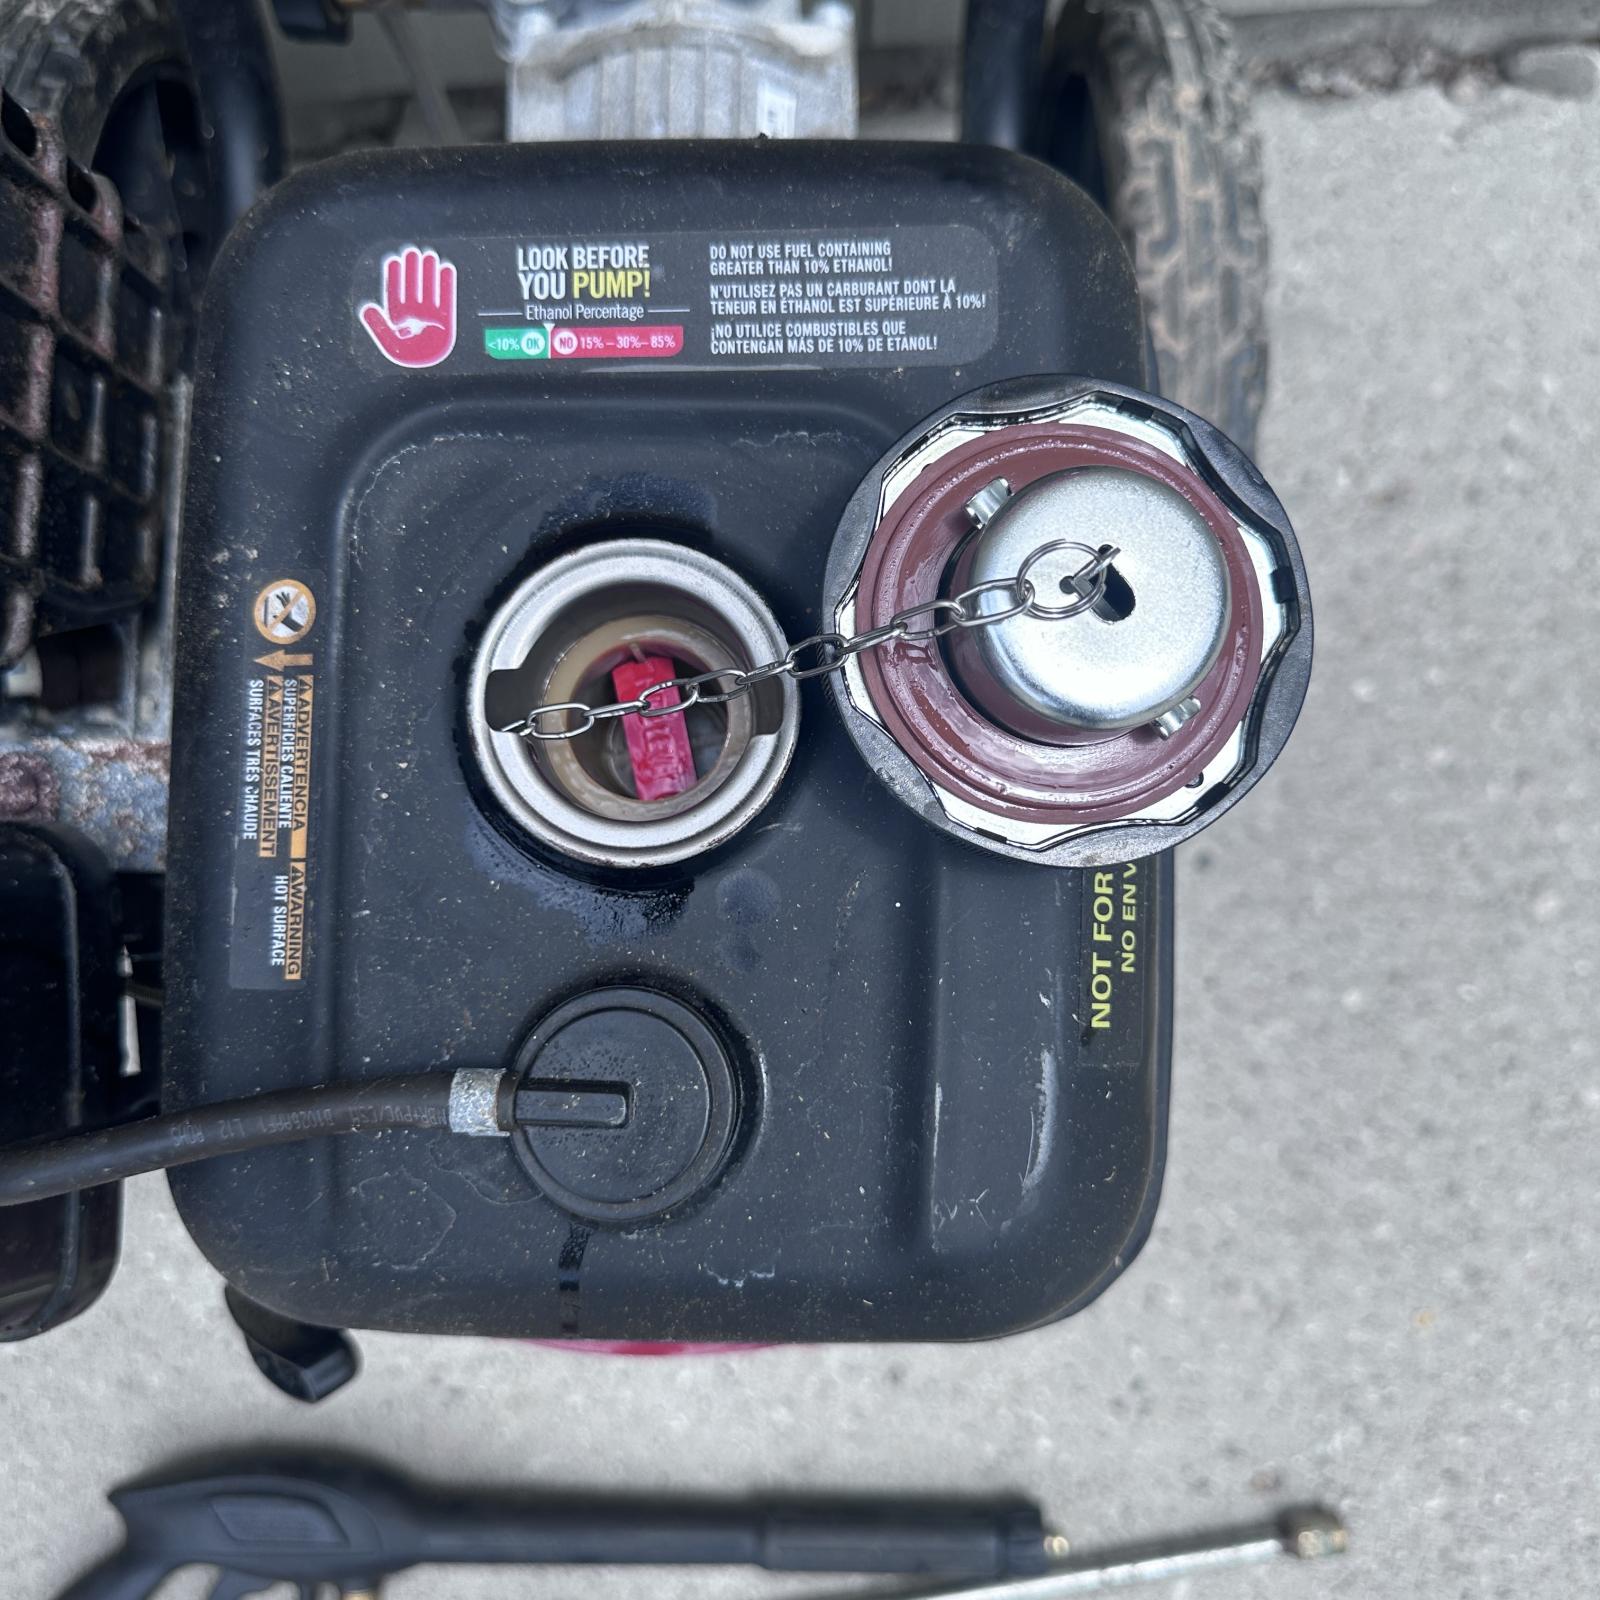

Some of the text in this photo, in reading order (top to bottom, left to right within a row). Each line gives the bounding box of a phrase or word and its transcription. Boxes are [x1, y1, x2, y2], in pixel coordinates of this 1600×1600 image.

[517, 246, 650, 271] LOOK BEFORE
[710, 242, 891, 259] DO NOT USE FUEL CONTAINING
[710, 258, 892, 276] GREATER THAN 10% ETHANOL!
[519, 271, 650, 300] YOU PUMP!
[780, 284, 802, 298] PAS
[807, 284, 823, 297] UN
[827, 282, 899, 296] CARBURANT
[904, 280, 935, 294] DONT
[940, 280, 955, 293] LA
[526, 304, 644, 320] Ethanol Percentage
[711, 292, 986, 315] TENEUR EN ÉTHANOL EST SUPÉRIEURE À 10%!
[488, 336, 540, 351] <10% OK
[559, 336, 573, 349] NO
[580, 336, 604, 349] 15%
[651, 336, 675, 348] 85%
[711, 321, 906, 341] ¡NO UTILICE COMBUSTIBLES QUE
[711, 336, 937, 355] CONTENGAN MÁS DE 10% DE ETANOL!
[247, 679, 264, 746] SURFACES
[279, 679, 297, 829] SUPERFICIES CALIENTE
[294, 698, 310, 831] ADVERTENCIA
[262, 699, 281, 855] AVERTISSEMENT
[243, 786, 259, 840] CHAUDE
[1122, 884, 1136, 921] EN
[271, 875, 288, 966] HOT SURFACE
[288, 882, 304, 975] WARNING
[1091, 871, 1114, 1028] NOT FOR
[1121, 930, 1136, 973] NO
